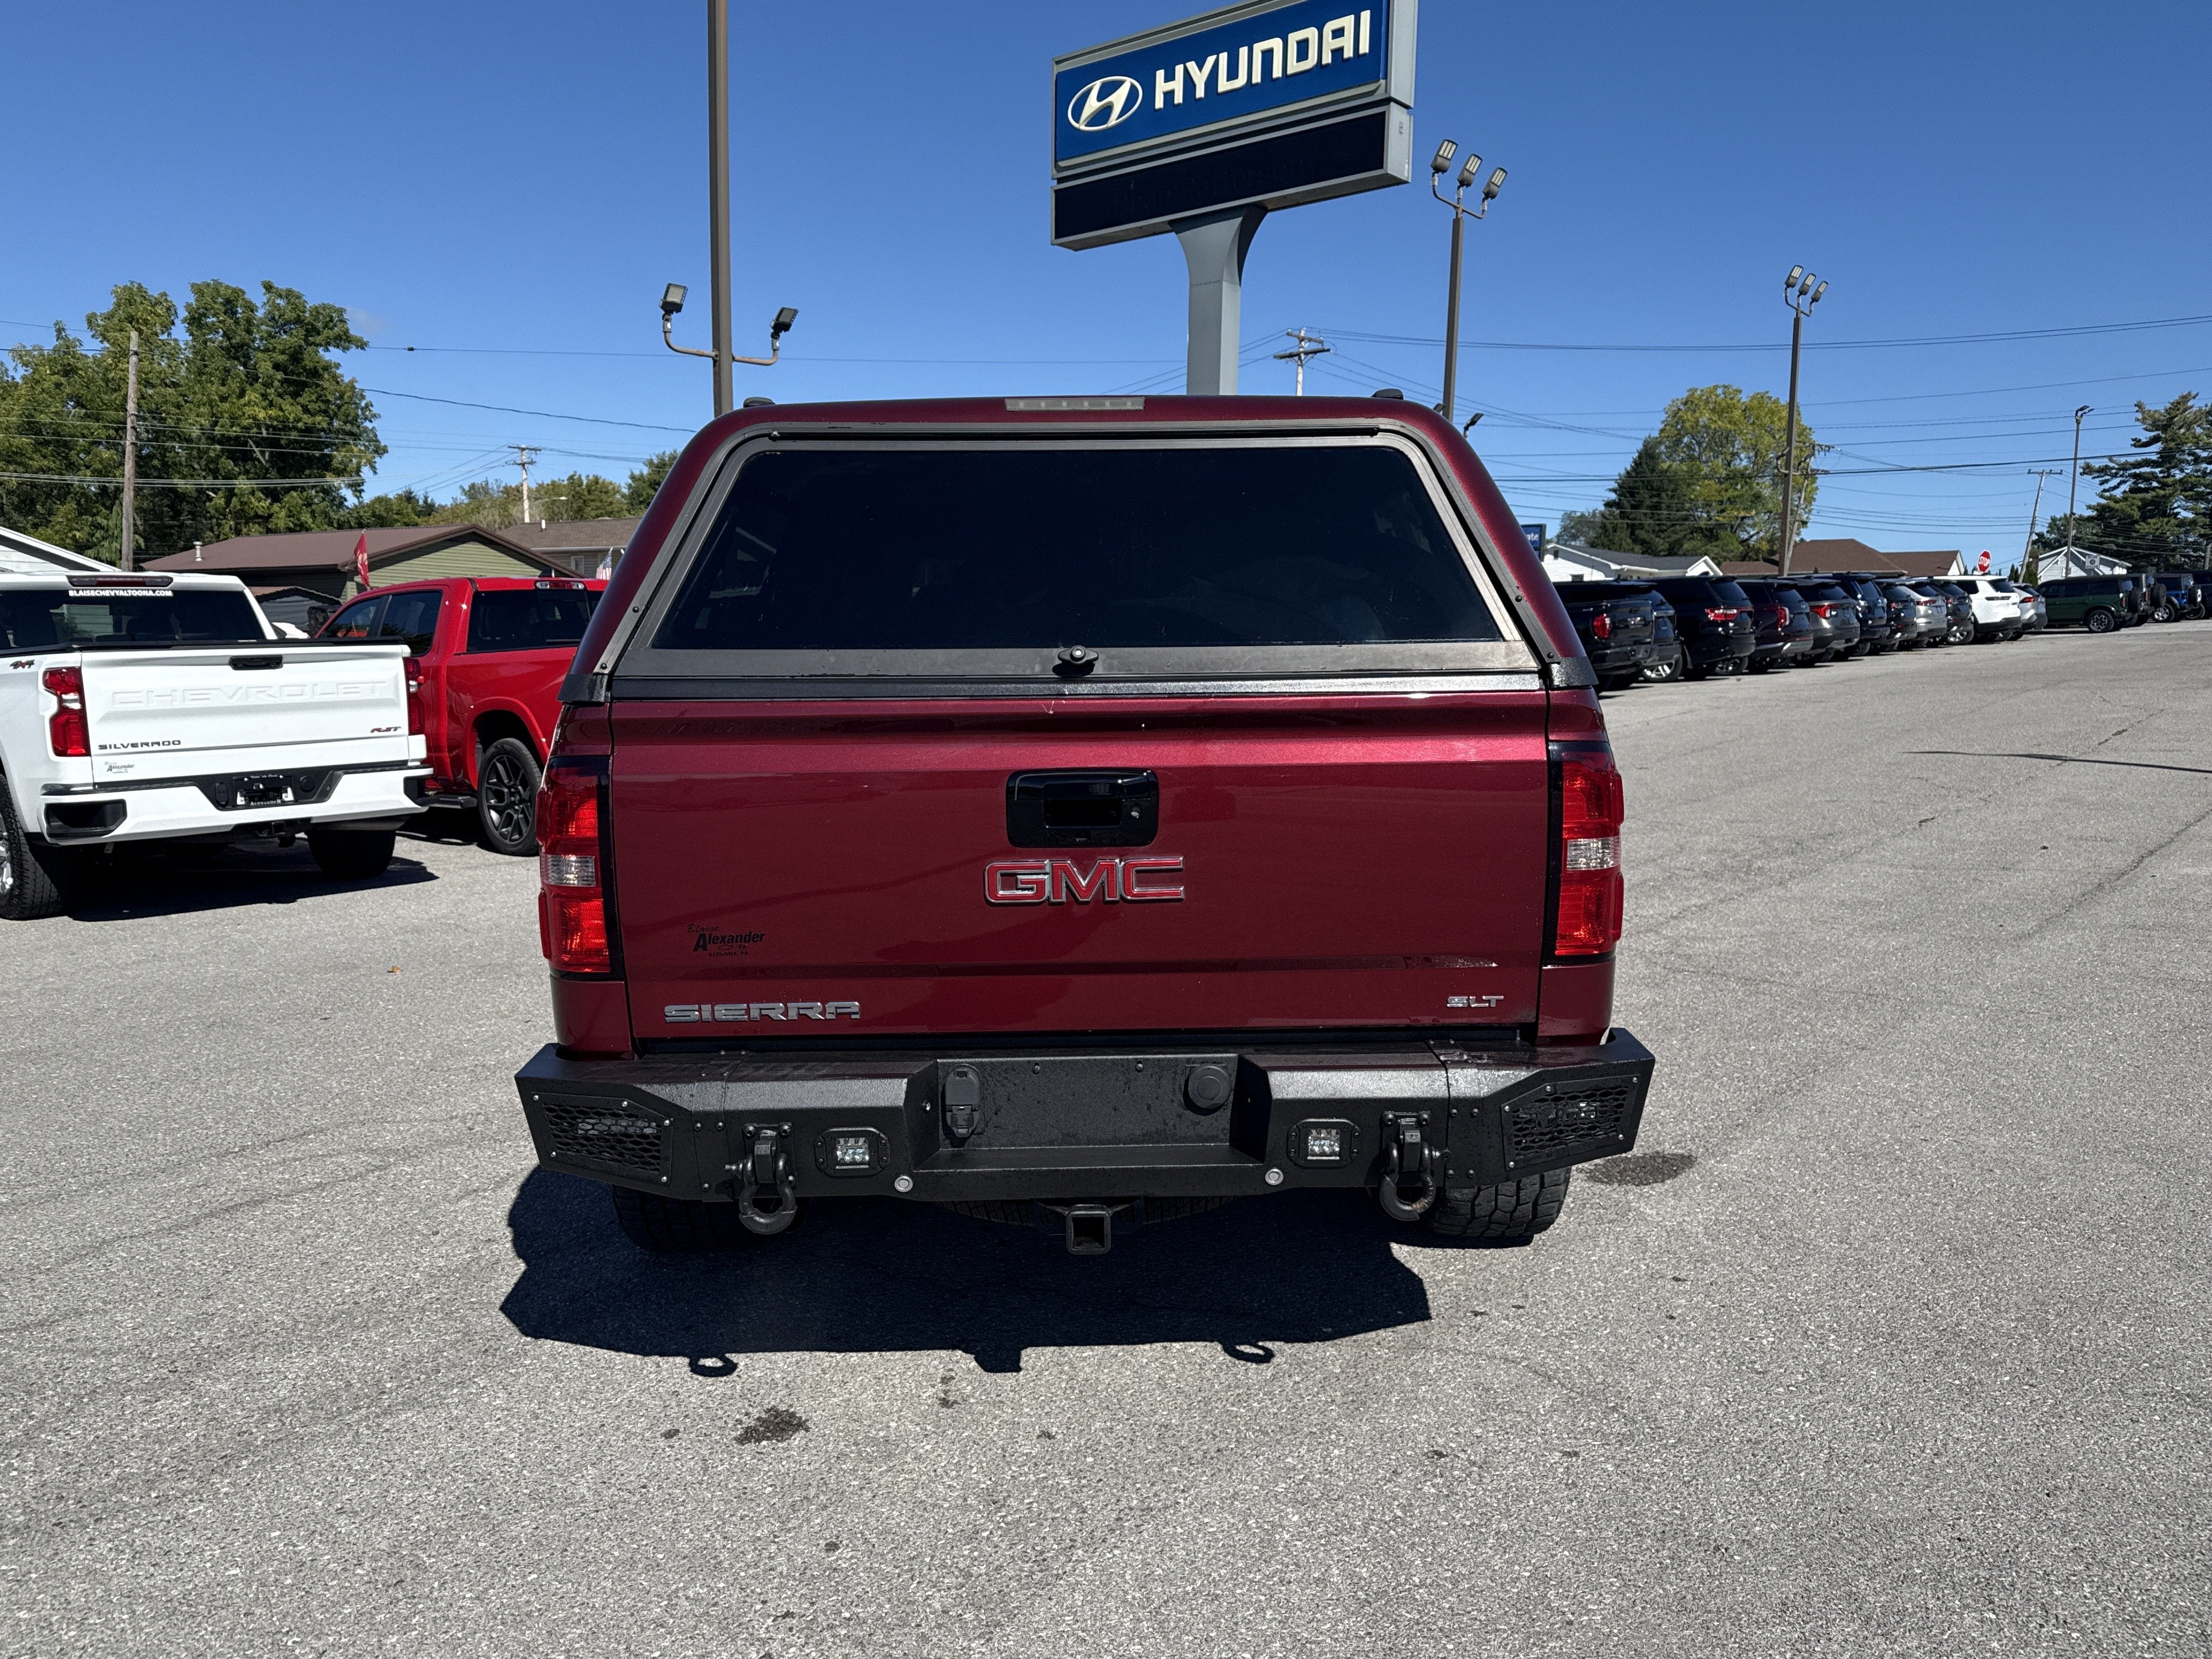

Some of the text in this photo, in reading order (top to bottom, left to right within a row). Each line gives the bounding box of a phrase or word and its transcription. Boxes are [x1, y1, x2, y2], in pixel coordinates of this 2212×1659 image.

[1154, 9, 1371, 110] HYUNDAI
[1978, 556, 1990, 567] STOP
[112, 680, 388, 707] CHEVROLET
[98, 740, 181, 750] SILVERADO
[984, 856, 1186, 903] GMC
[687, 923, 719, 933] Blaise
[693, 931, 766, 952] Alexander
[664, 1001, 861, 1023] SIERRA
[1447, 995, 1504, 1008] SLT
